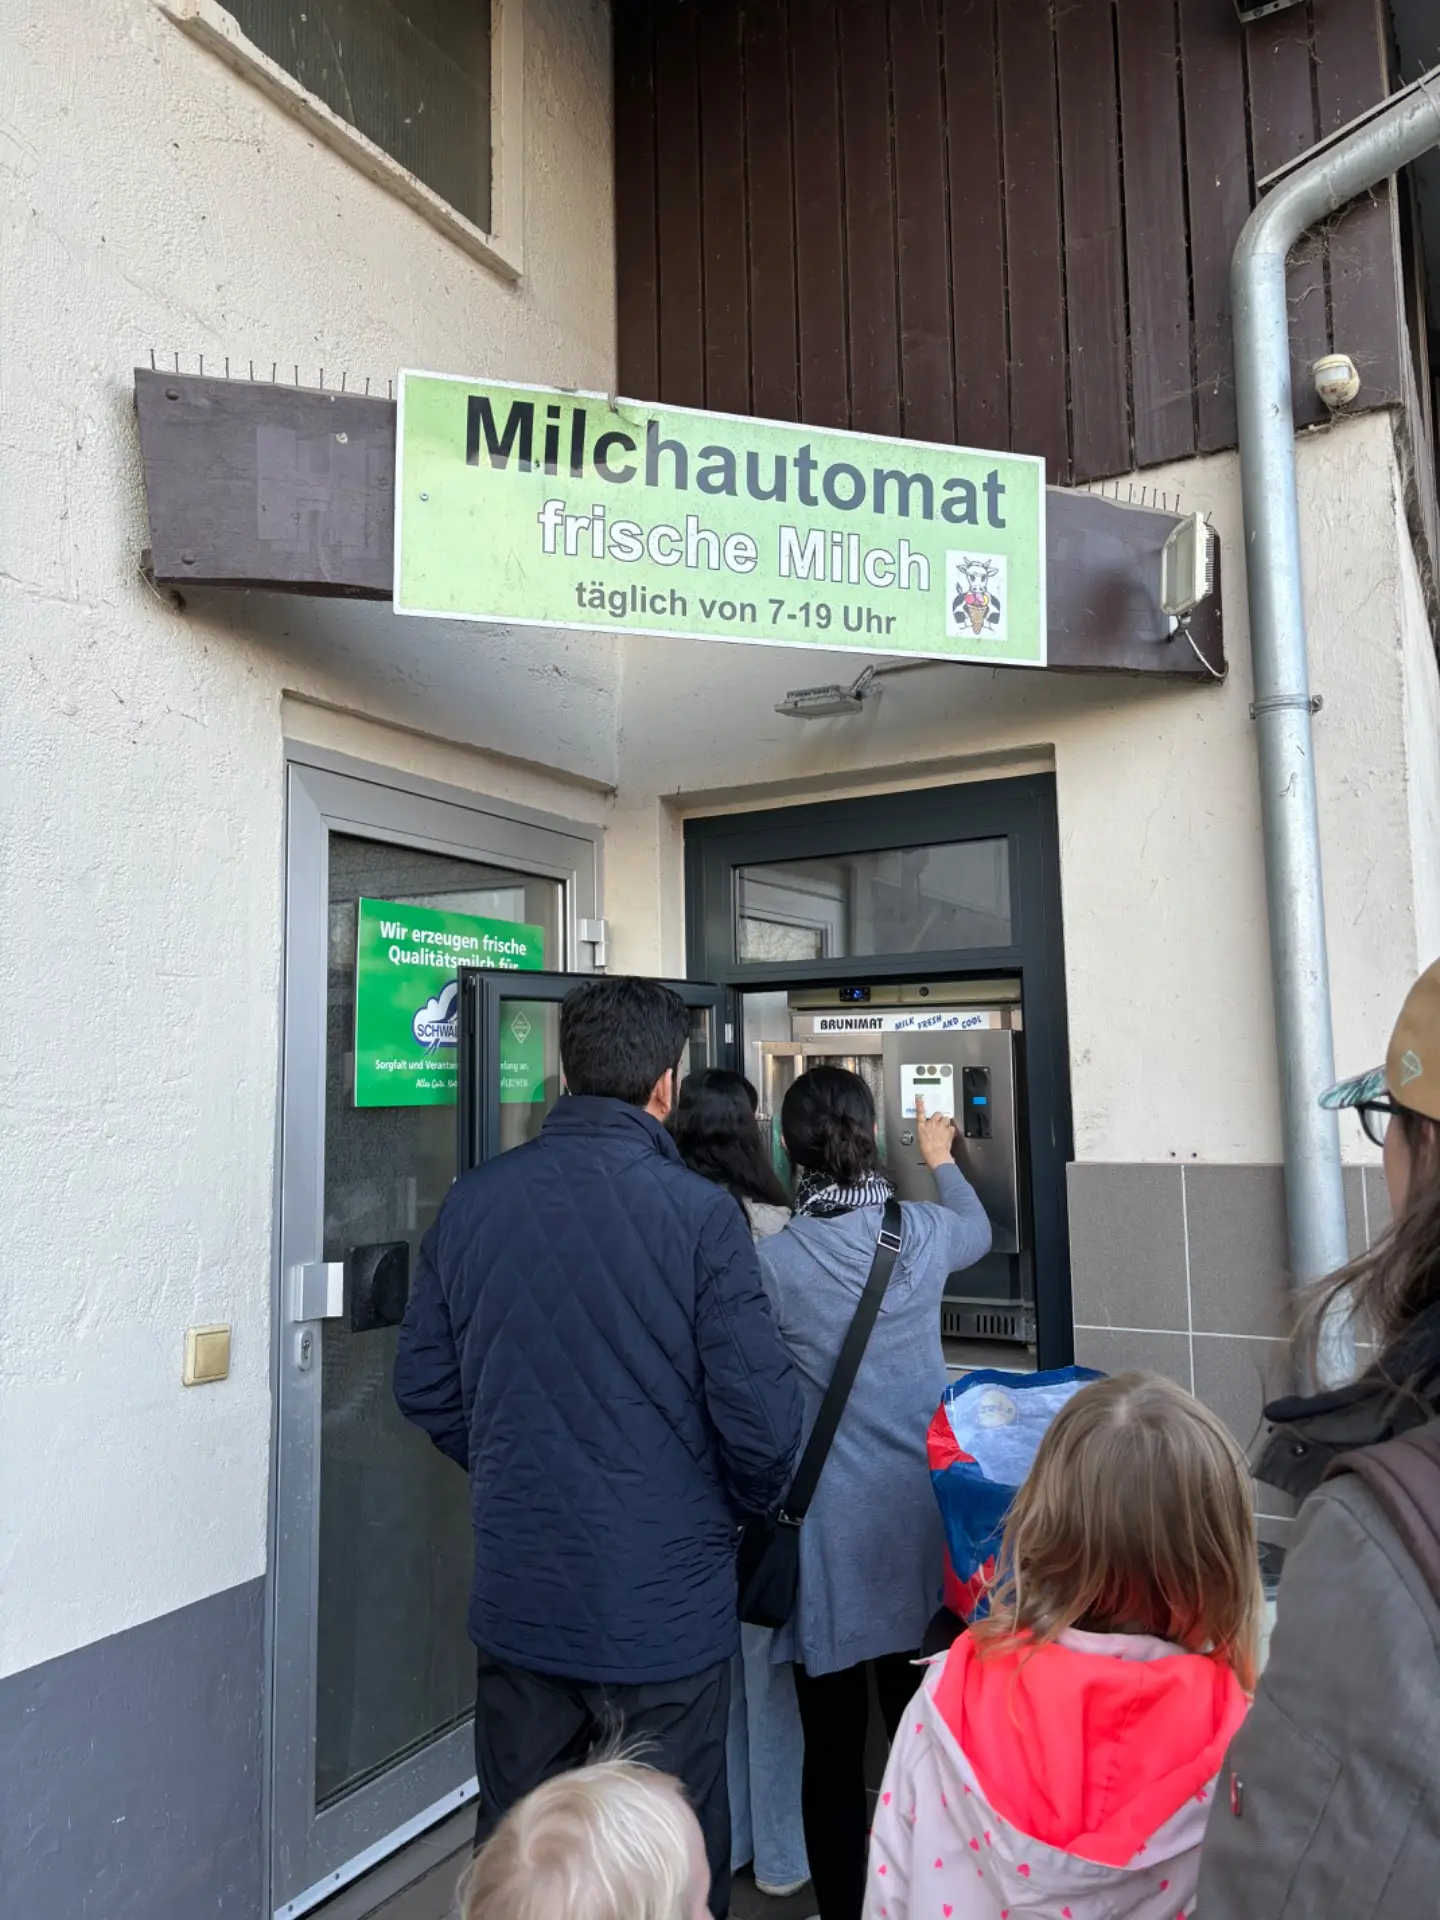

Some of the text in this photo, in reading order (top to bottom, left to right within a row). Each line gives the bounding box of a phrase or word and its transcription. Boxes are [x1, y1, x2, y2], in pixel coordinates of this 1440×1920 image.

[465, 394, 1006, 528] Milchautomat
[537, 498, 931, 591] frische Milch
[575, 580, 897, 635] täglich von 7-19 Uhr
[380, 920, 527, 956] Wir erzeugen frische
[388, 945, 519, 970] Qualitätsmilch für
[820, 1017, 884, 1030] BRUNIMAT
[894, 1014, 982, 1031] MILK FRESH AND COOL
[375, 1058, 407, 1072] Sorgfalt
[409, 1059, 423, 1070] und
